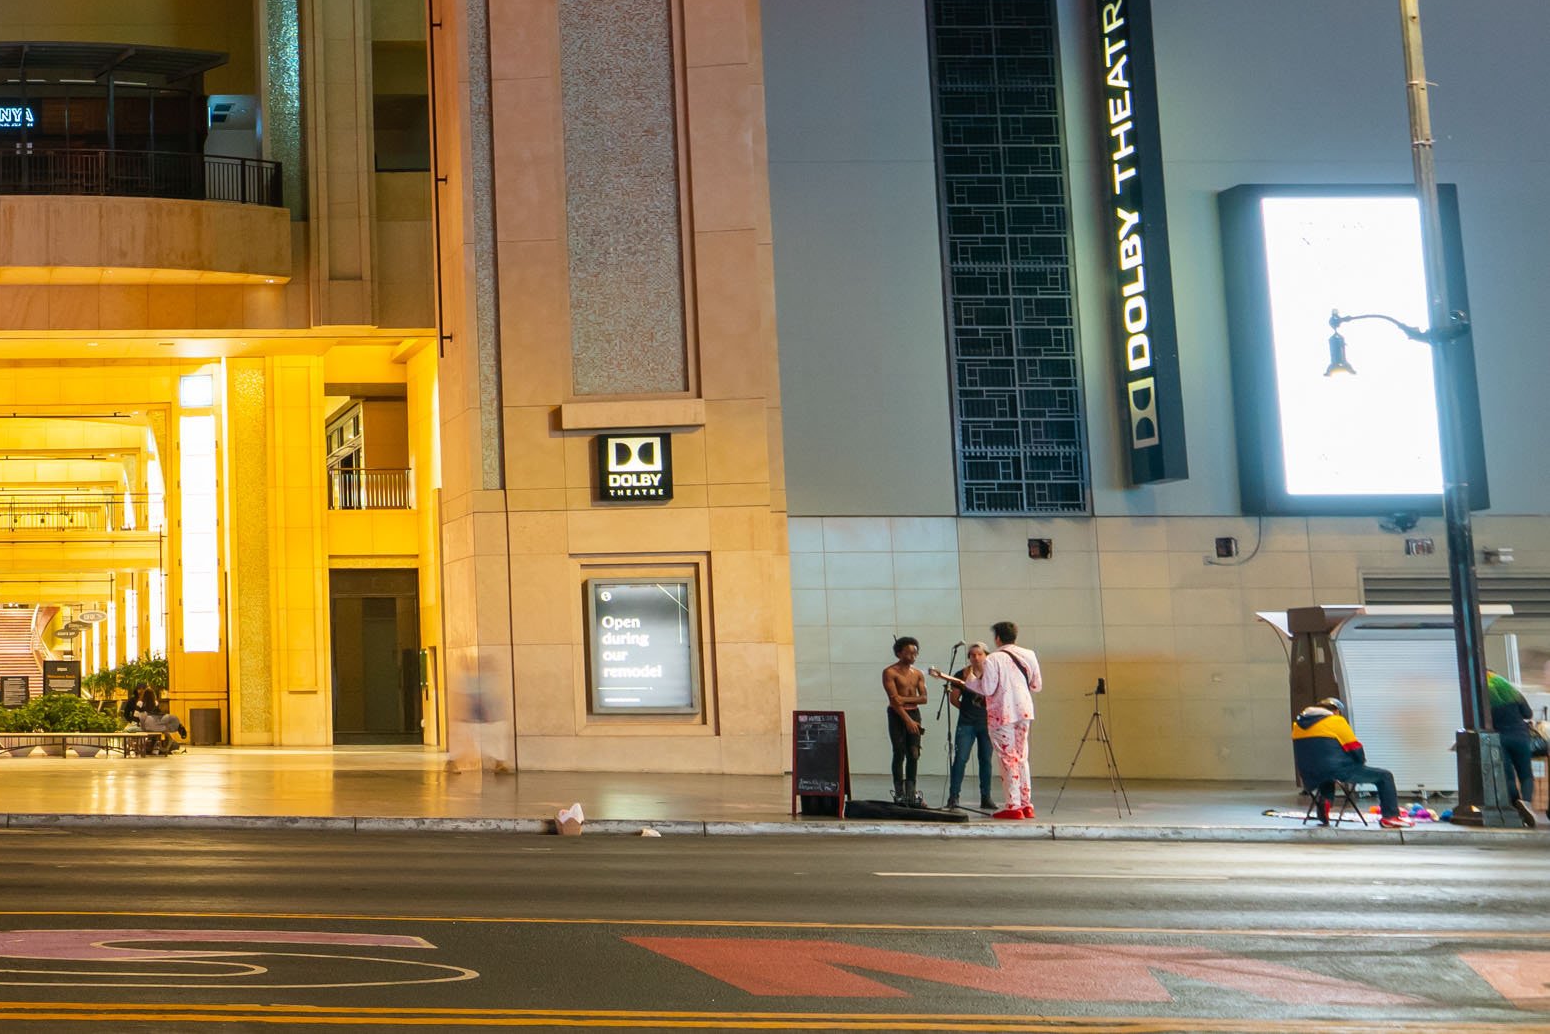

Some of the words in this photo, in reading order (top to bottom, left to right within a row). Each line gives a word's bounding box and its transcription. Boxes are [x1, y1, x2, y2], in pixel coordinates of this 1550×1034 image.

[1117, 207, 1152, 372] DOLBY
[608, 473, 662, 487] DOLBY
[610, 489, 664, 497] THEATRE
[602, 616, 641, 631] Open
[602, 632, 650, 647] during
[602, 651, 629, 662] our
[603, 665, 663, 678] remodel
